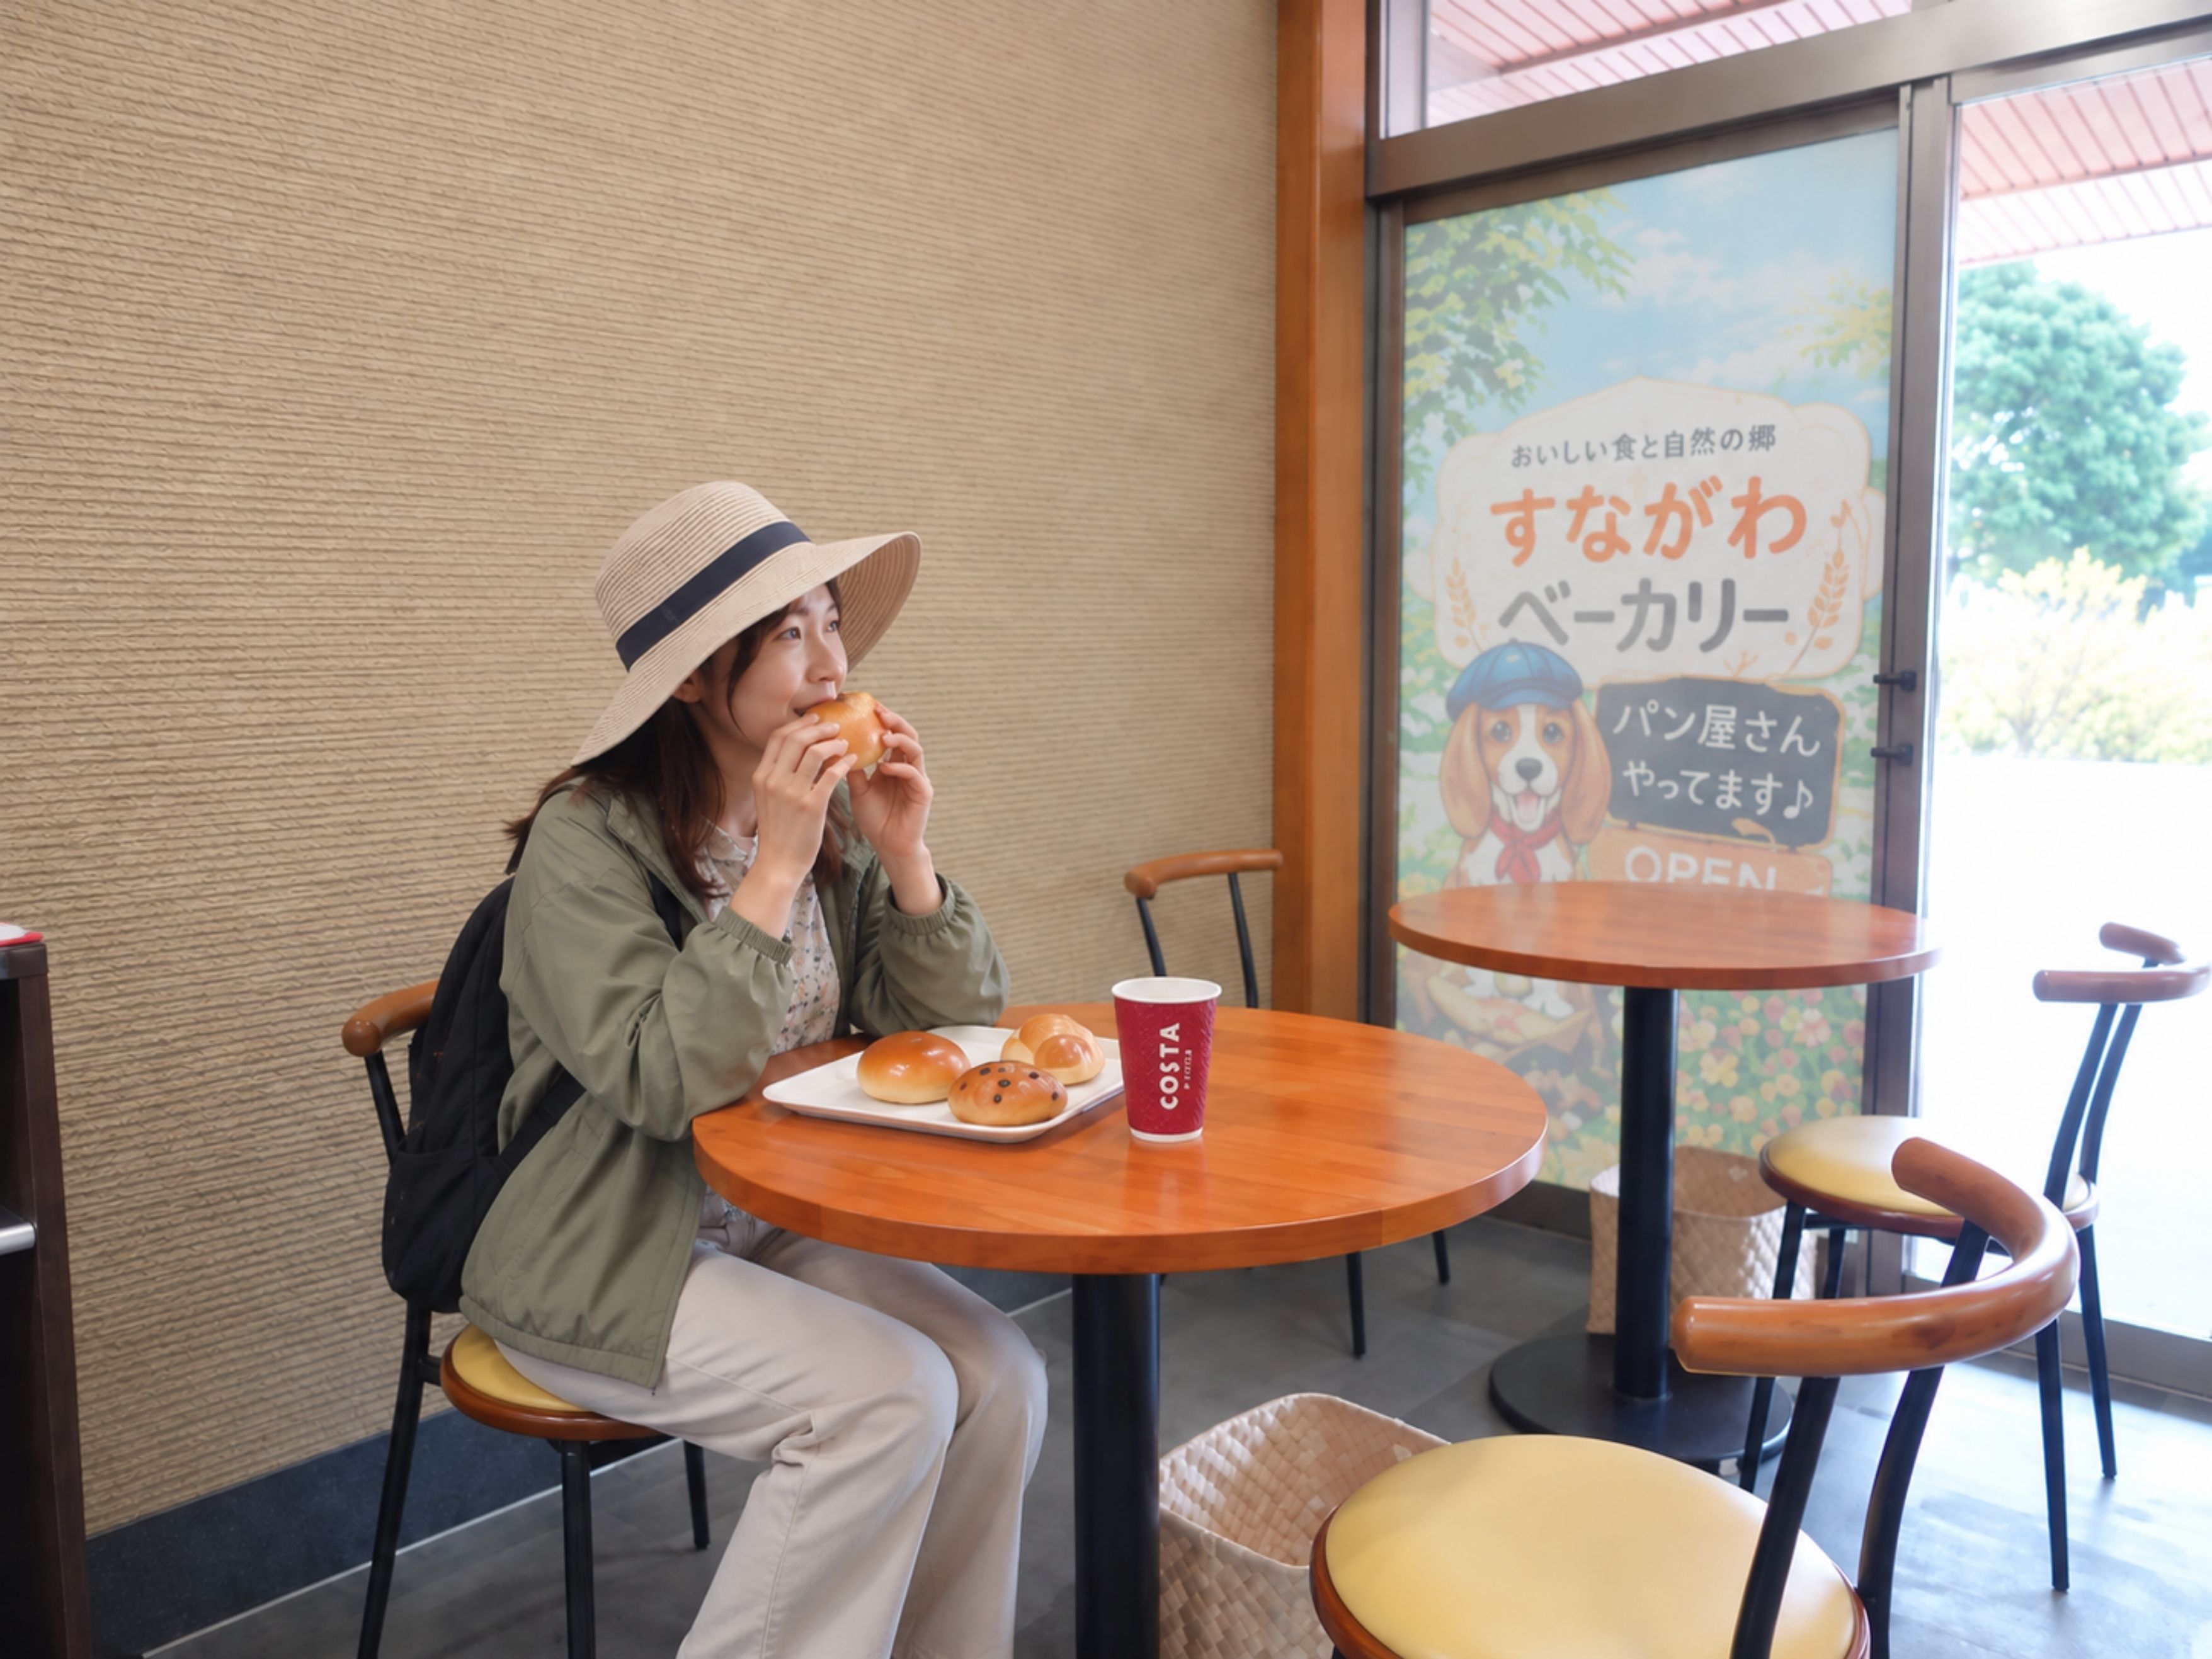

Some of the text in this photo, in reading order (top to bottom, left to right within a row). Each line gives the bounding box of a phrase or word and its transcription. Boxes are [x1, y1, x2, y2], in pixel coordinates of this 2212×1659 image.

[1512, 424, 1776, 468] おいしい食と自然の郷
[1490, 475, 1806, 567] すながわ
[1498, 578, 1789, 653] ベーカリー
[1612, 698, 1820, 756] パン屋さん
[1160, 1022, 1180, 1110] COSTA
